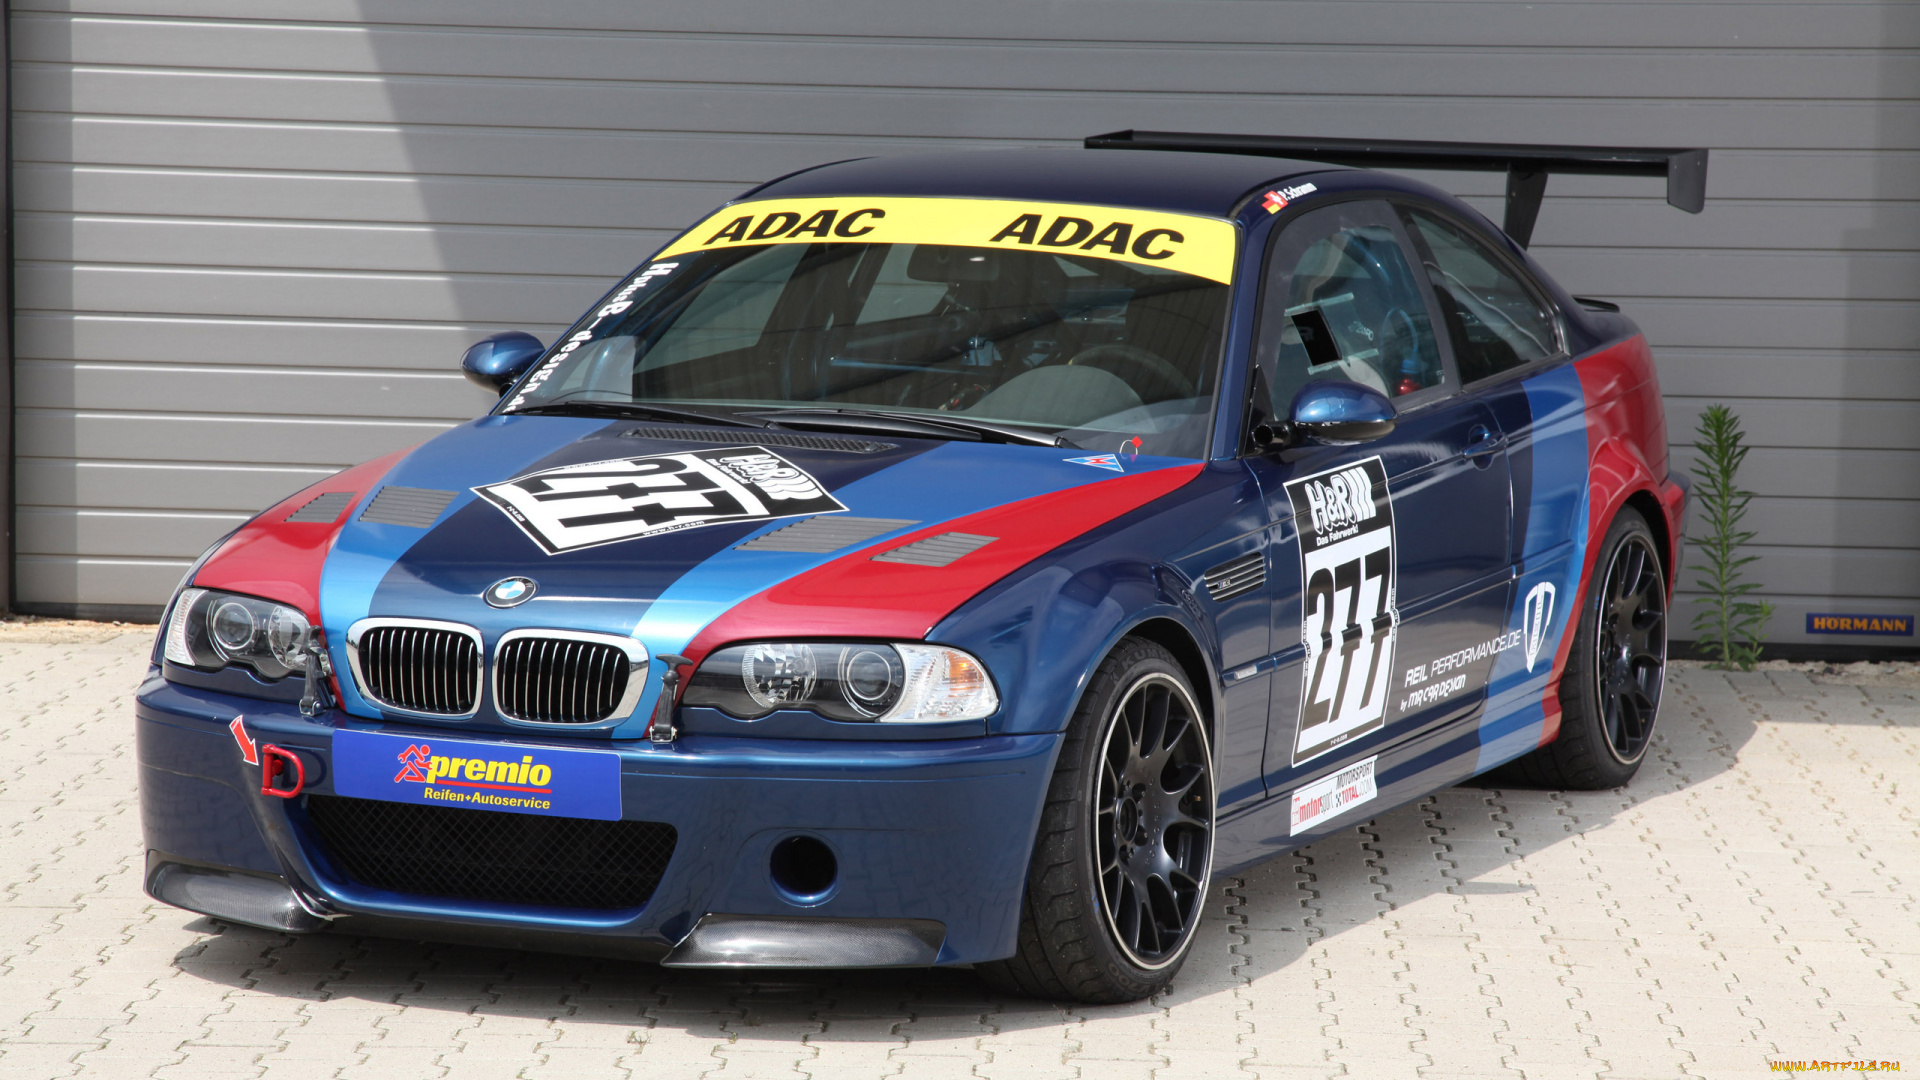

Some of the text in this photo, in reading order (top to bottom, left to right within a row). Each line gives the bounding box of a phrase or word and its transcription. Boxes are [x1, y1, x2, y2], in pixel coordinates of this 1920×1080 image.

[703, 208, 886, 245] ADAC
[989, 213, 1186, 260] ADAC
[510, 458, 749, 528] 277
[1304, 474, 1357, 534] H&R
[1316, 534, 1329, 546] Das
[1301, 546, 1392, 731] 277
[1405, 629, 1522, 688] REIL PERFORMANCE.DE
[426, 754, 552, 787] premio
[1336, 761, 1373, 790] MOTORSPORT
[424, 786, 551, 810] Reifen+Autoservice
